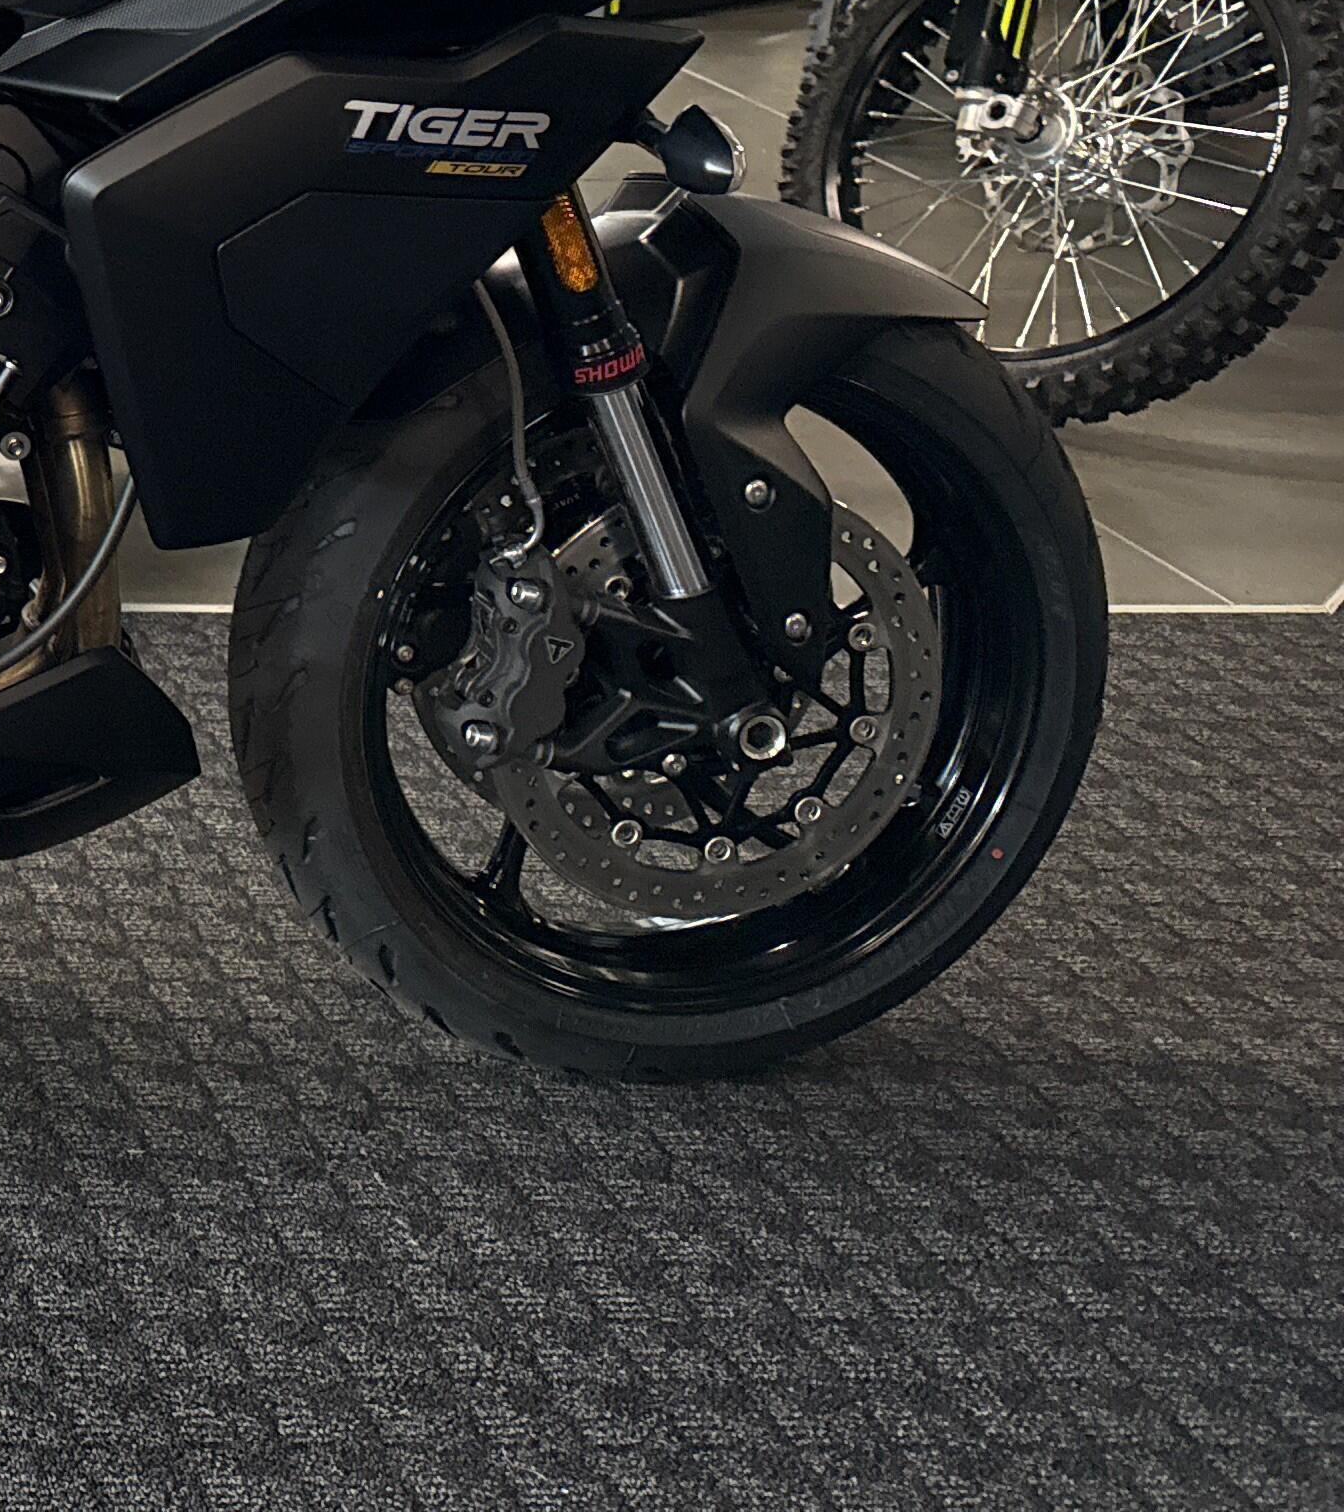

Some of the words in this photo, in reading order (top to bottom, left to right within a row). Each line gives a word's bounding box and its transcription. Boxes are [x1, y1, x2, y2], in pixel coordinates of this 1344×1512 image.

[343, 99, 551, 149] TIGER
[447, 162, 522, 176] TOUR
[574, 342, 647, 384] SHOWA
